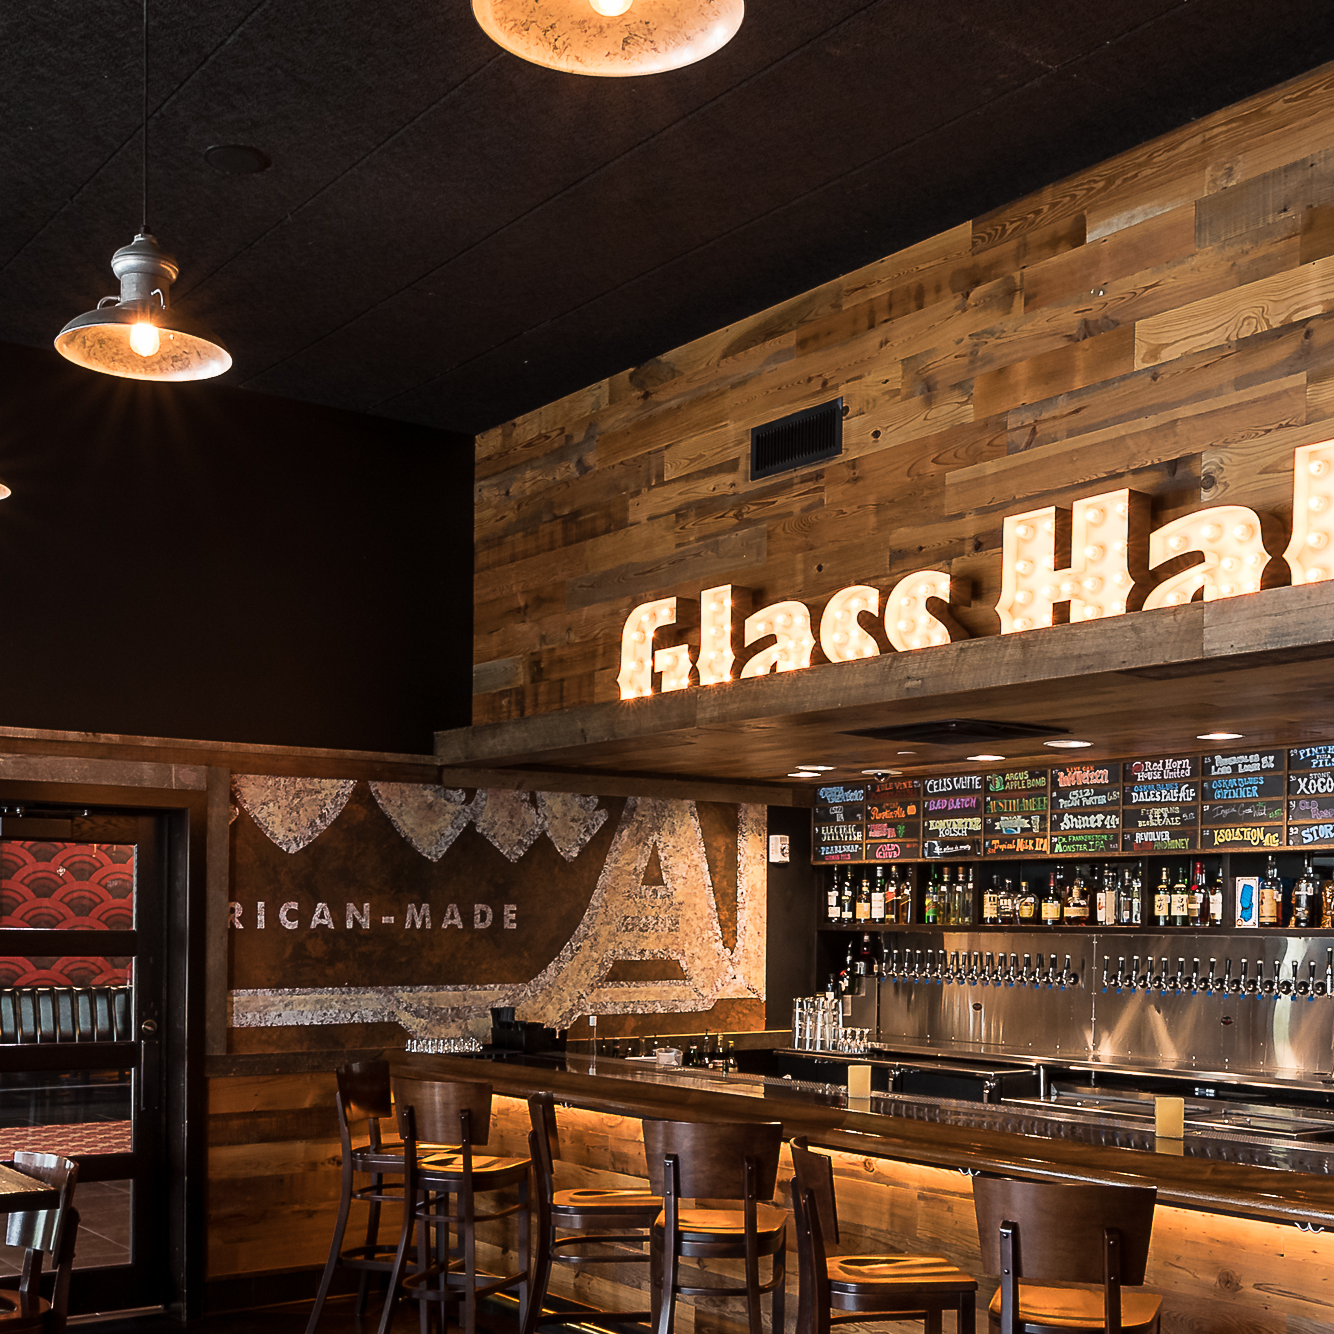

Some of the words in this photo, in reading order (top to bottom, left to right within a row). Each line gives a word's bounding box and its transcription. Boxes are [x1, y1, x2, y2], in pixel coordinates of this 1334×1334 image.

[615, 570, 959, 701] Glass
[1144, 760, 1164, 772] Red
[1164, 758, 1191, 771] Horn
[1004, 770, 1029, 781] ARGUS
[1163, 767, 1192, 779] United
[1004, 780, 1027, 790] APPLE
[1027, 776, 1047, 788] BOMB
[1298, 799, 1319, 811] OLD
[821, 824, 857, 835] ELECTRIC
[821, 831, 862, 842] JELLYFISH
[1134, 830, 1171, 843] REVOLVER
